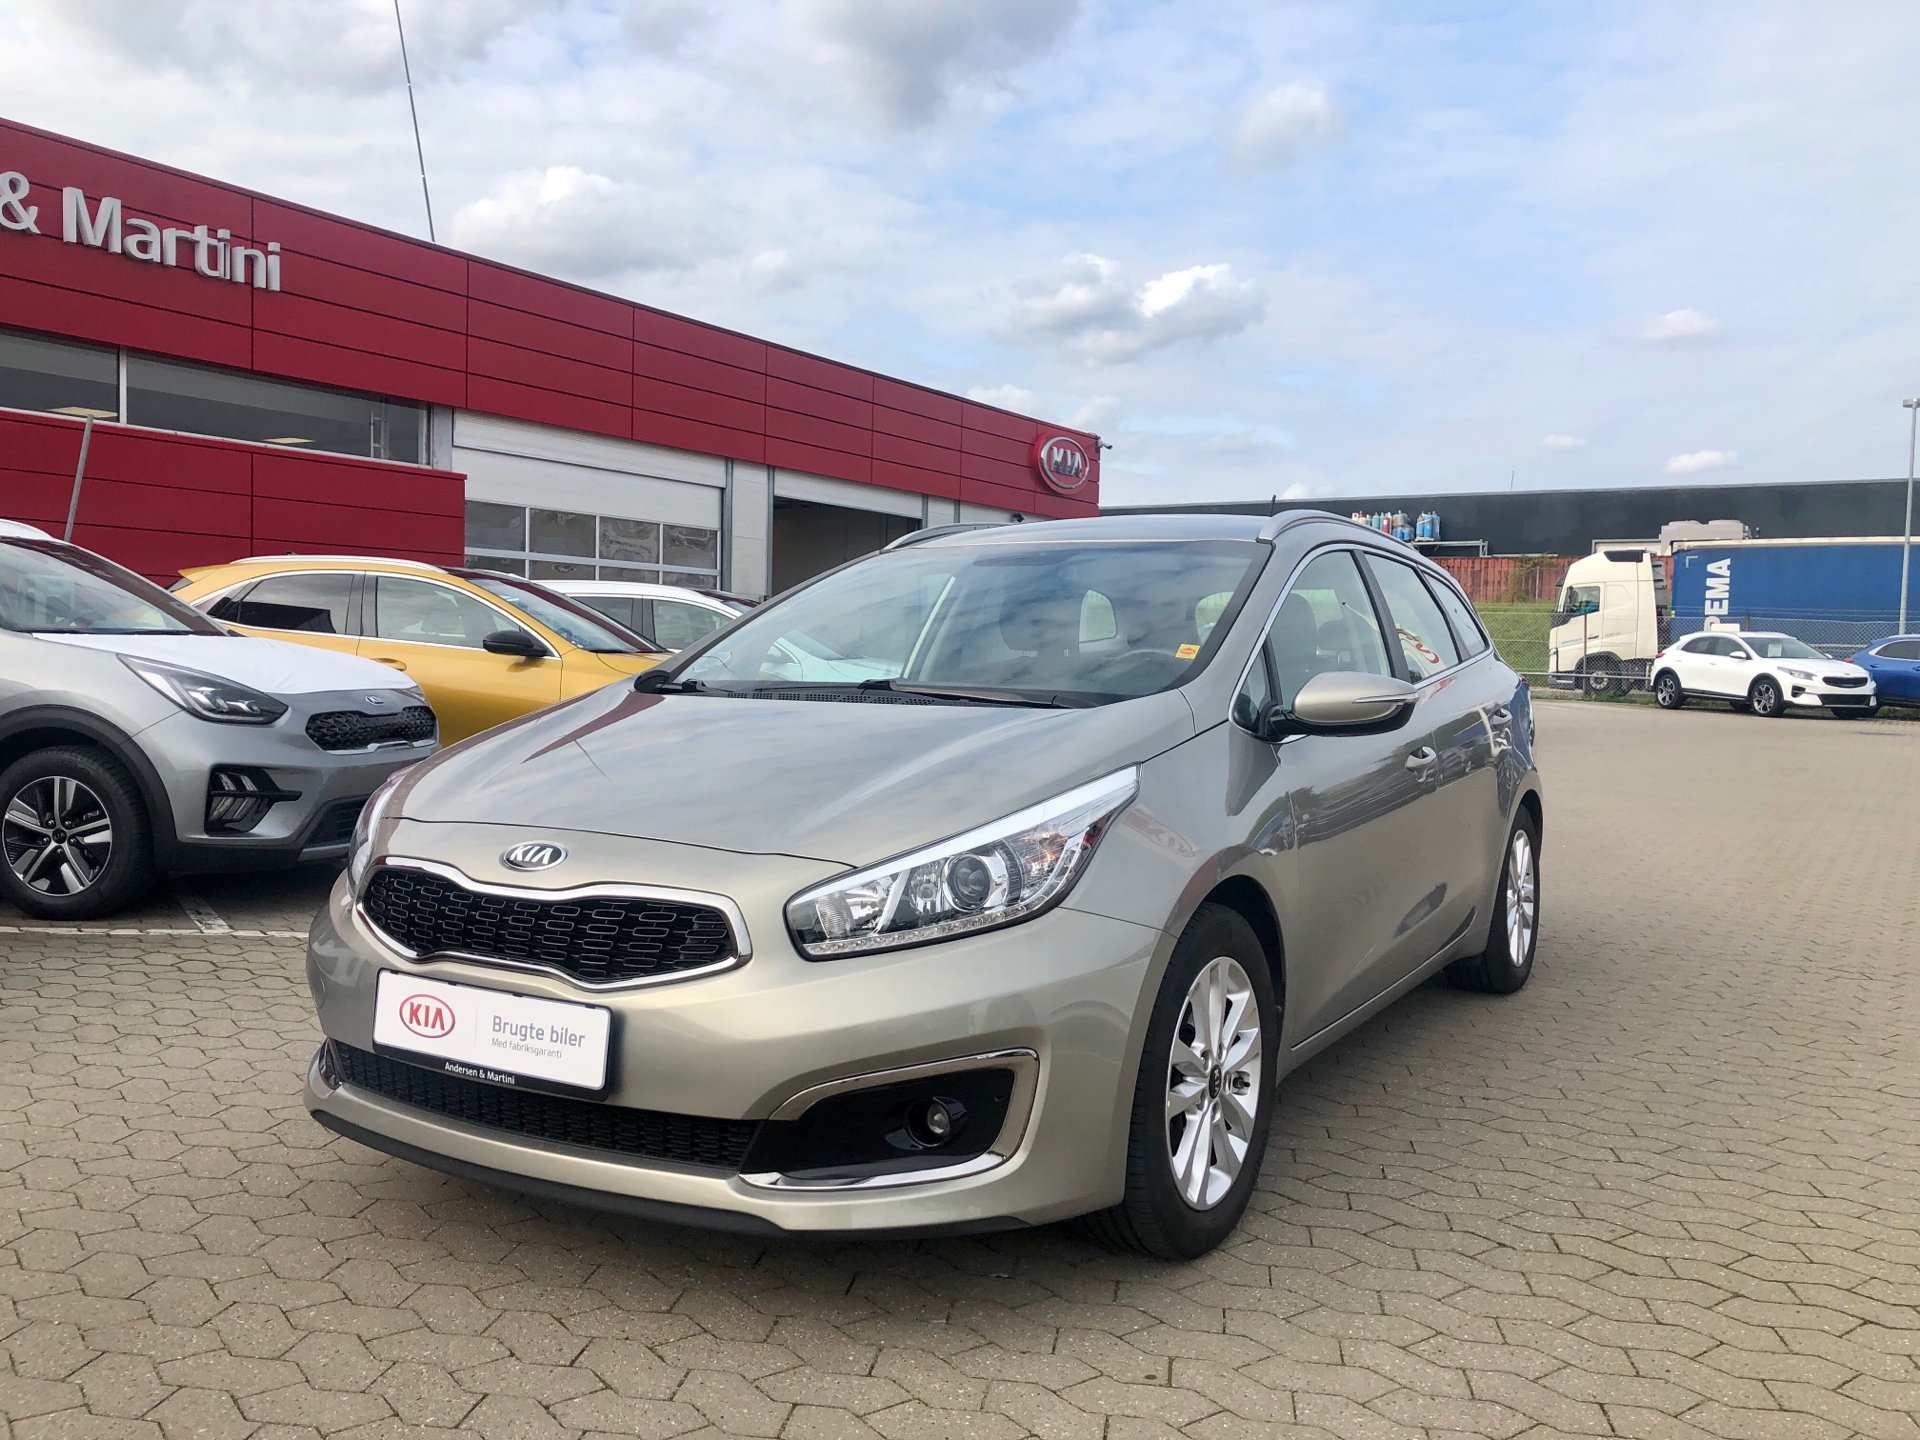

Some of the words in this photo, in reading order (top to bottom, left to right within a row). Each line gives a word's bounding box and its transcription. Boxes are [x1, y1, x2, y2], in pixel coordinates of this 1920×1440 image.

[0, 171, 41, 235] &
[62, 187, 281, 292] Martini
[1051, 446, 1083, 478] KIA
[509, 846, 554, 865] KIA
[408, 1001, 446, 1032] KIA
[492, 1014, 545, 1042] Brugte
[549, 1025, 586, 1048] biler
[491, 1037, 507, 1049] Med
[508, 1040, 563, 1059] fabriksgaranti
[444, 1061, 478, 1077] Andersen
[478, 1069, 486, 1079] &
[486, 1070, 516, 1085] Martini
